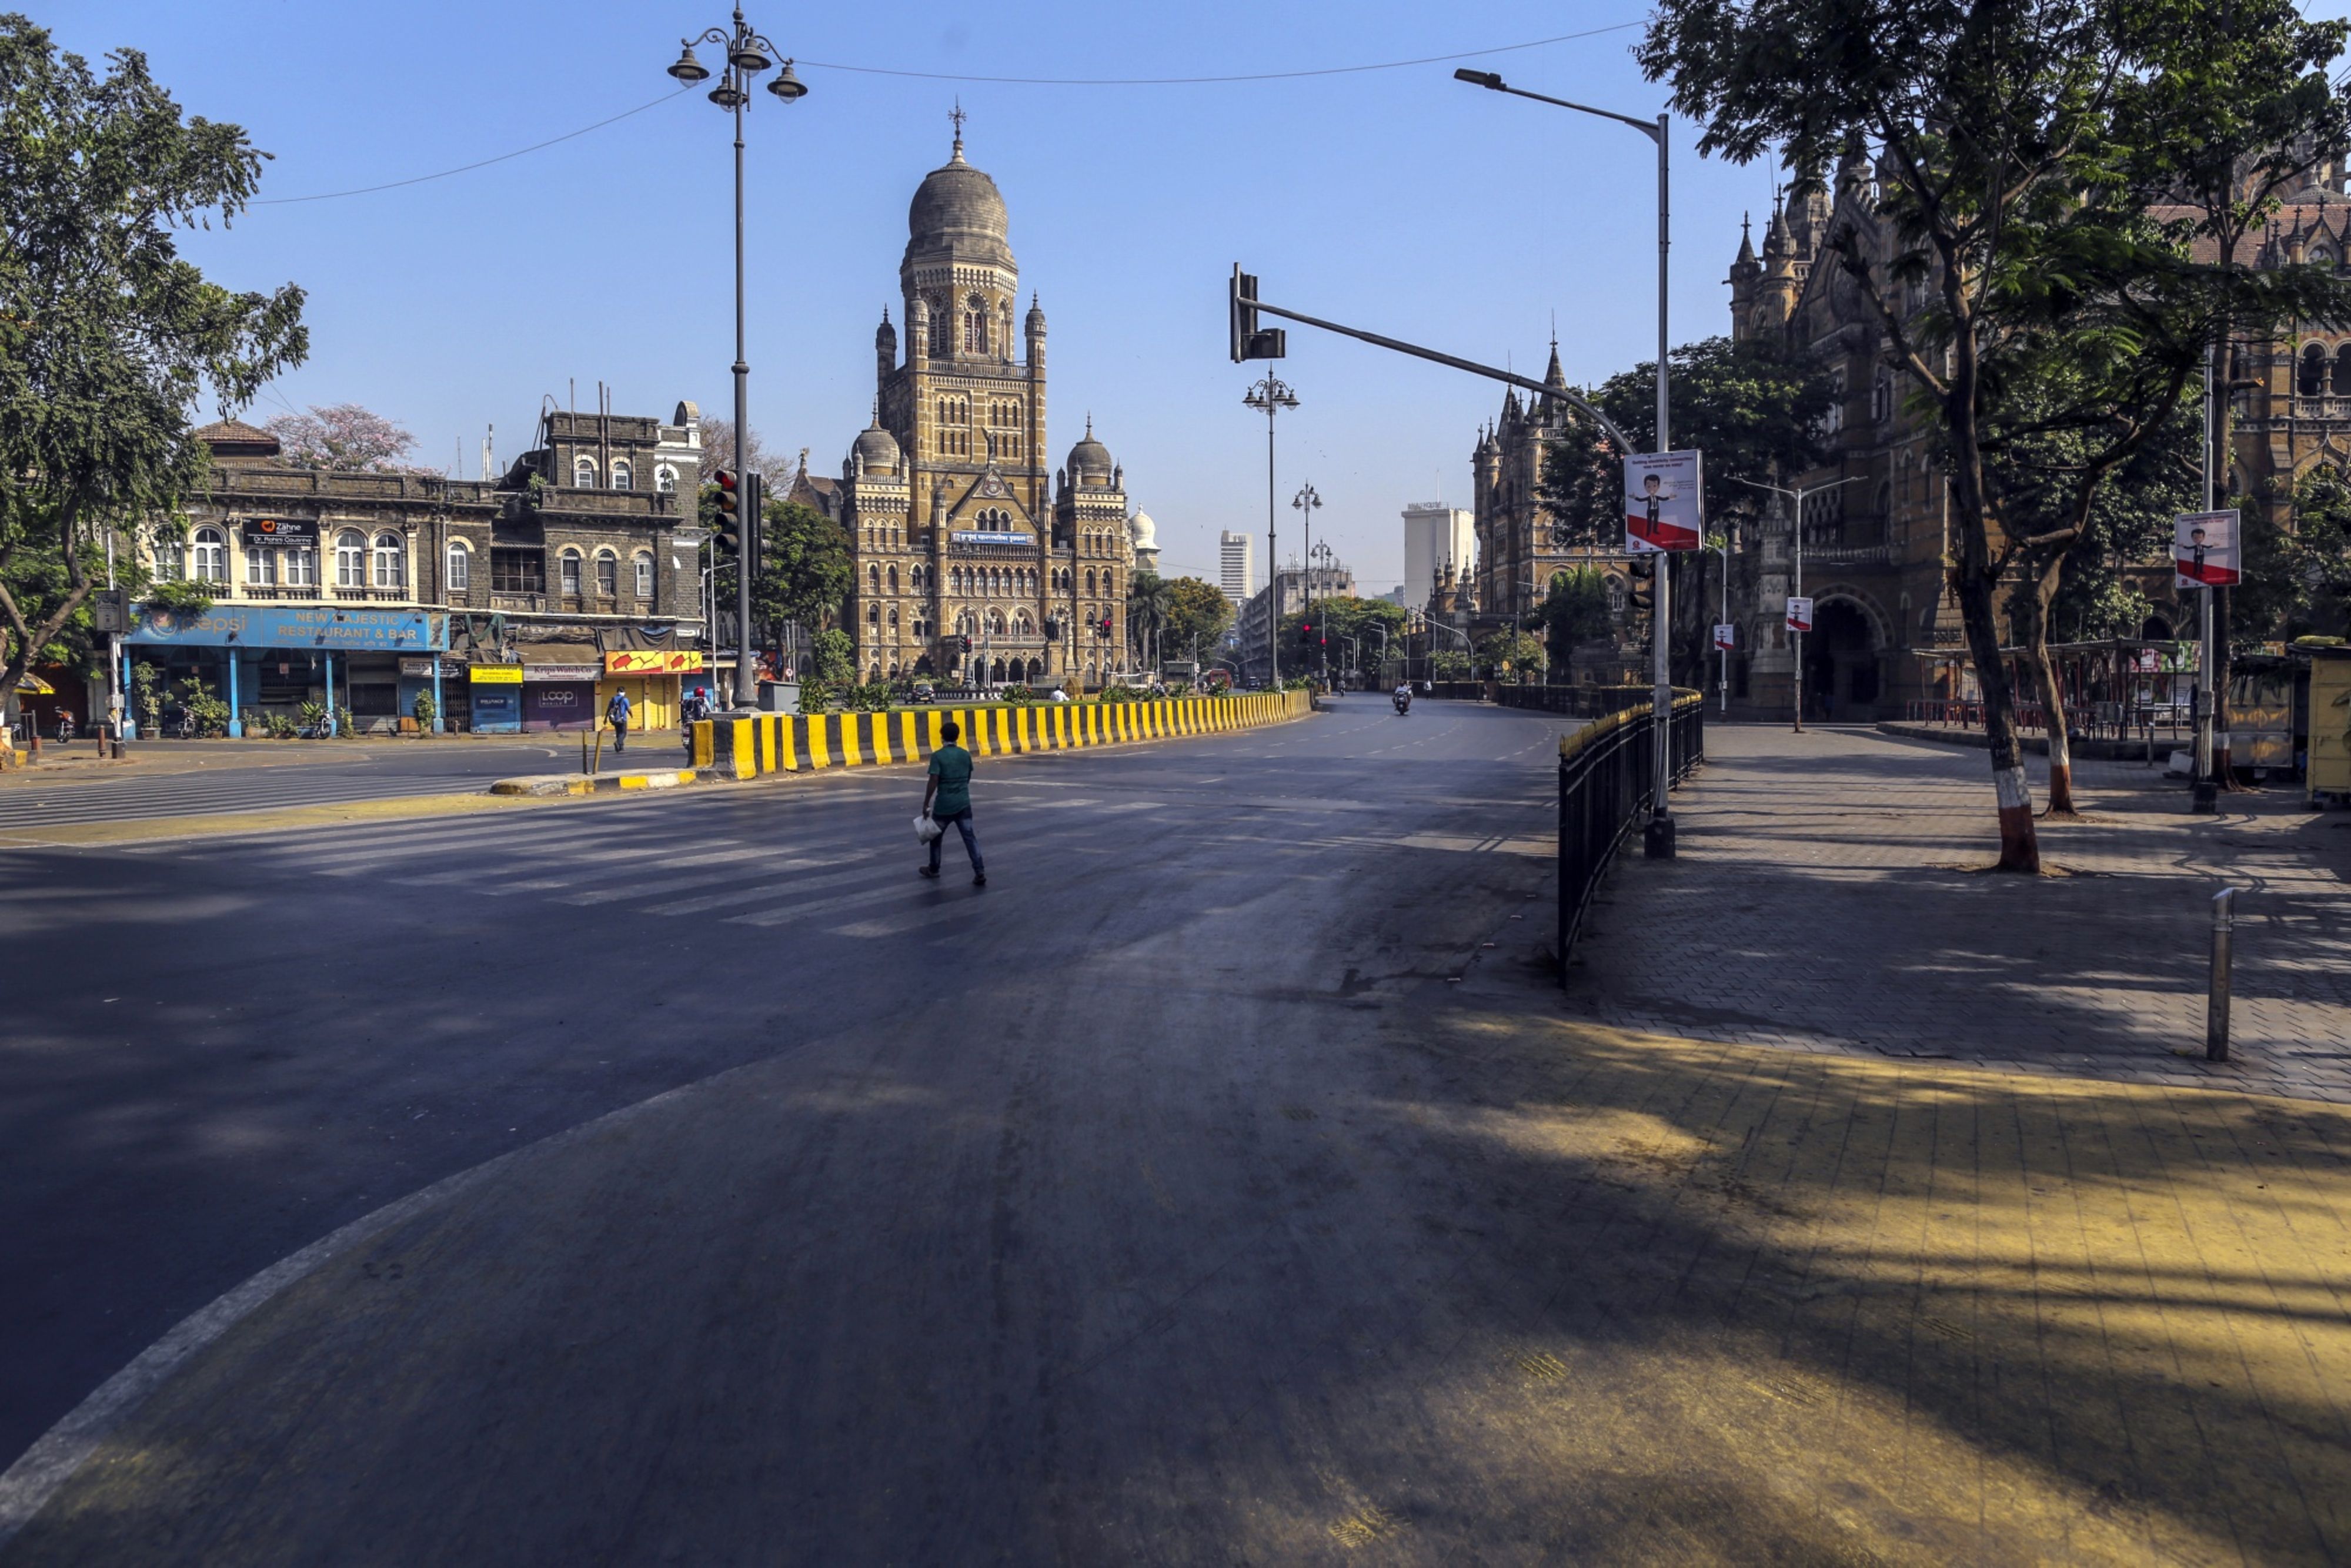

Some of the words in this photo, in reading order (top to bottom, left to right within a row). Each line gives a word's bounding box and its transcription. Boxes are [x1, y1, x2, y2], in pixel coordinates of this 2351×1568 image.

[182, 615, 246, 635] pepsi
[296, 612, 327, 623] NEW
[332, 613, 399, 626] MAJESTIC
[278, 626, 370, 638] RESTAURANT
[375, 628, 384, 639] &
[389, 628, 417, 640] BAR
